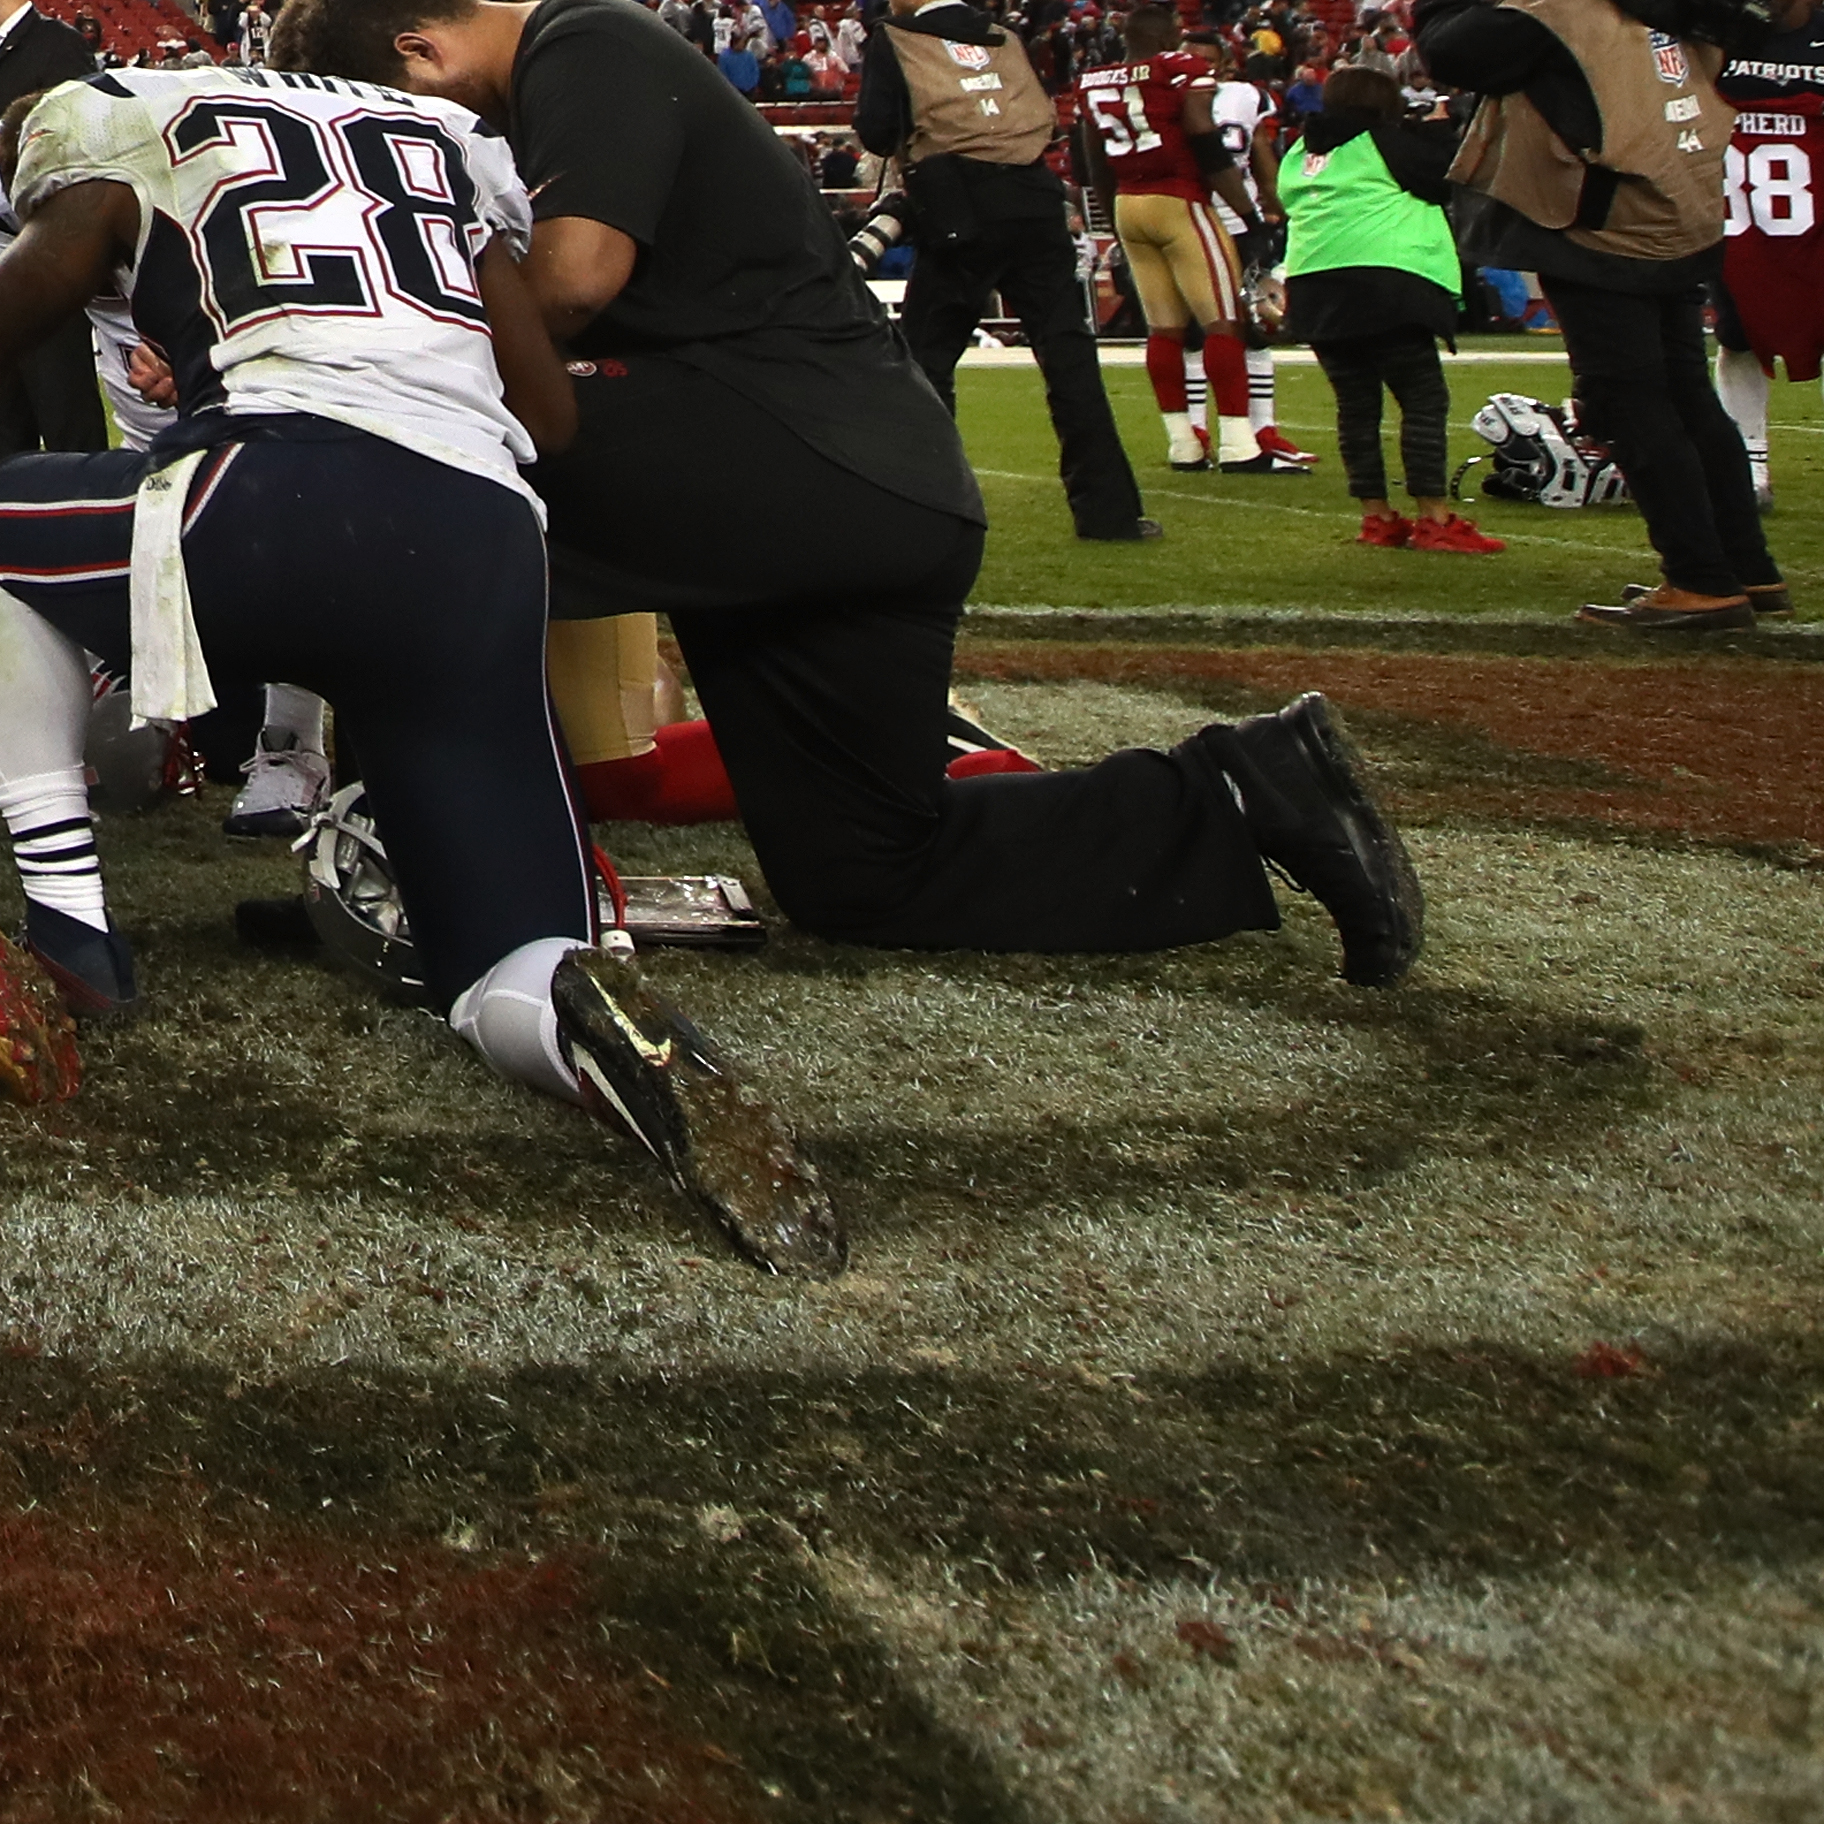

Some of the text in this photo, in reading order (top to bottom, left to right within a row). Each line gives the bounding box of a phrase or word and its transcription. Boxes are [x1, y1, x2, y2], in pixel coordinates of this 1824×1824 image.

[953, 44, 985, 64] NFL
[978, 97, 1001, 117] 14
[1087, 86, 1163, 157] 51
[163, 94, 493, 341] 28
